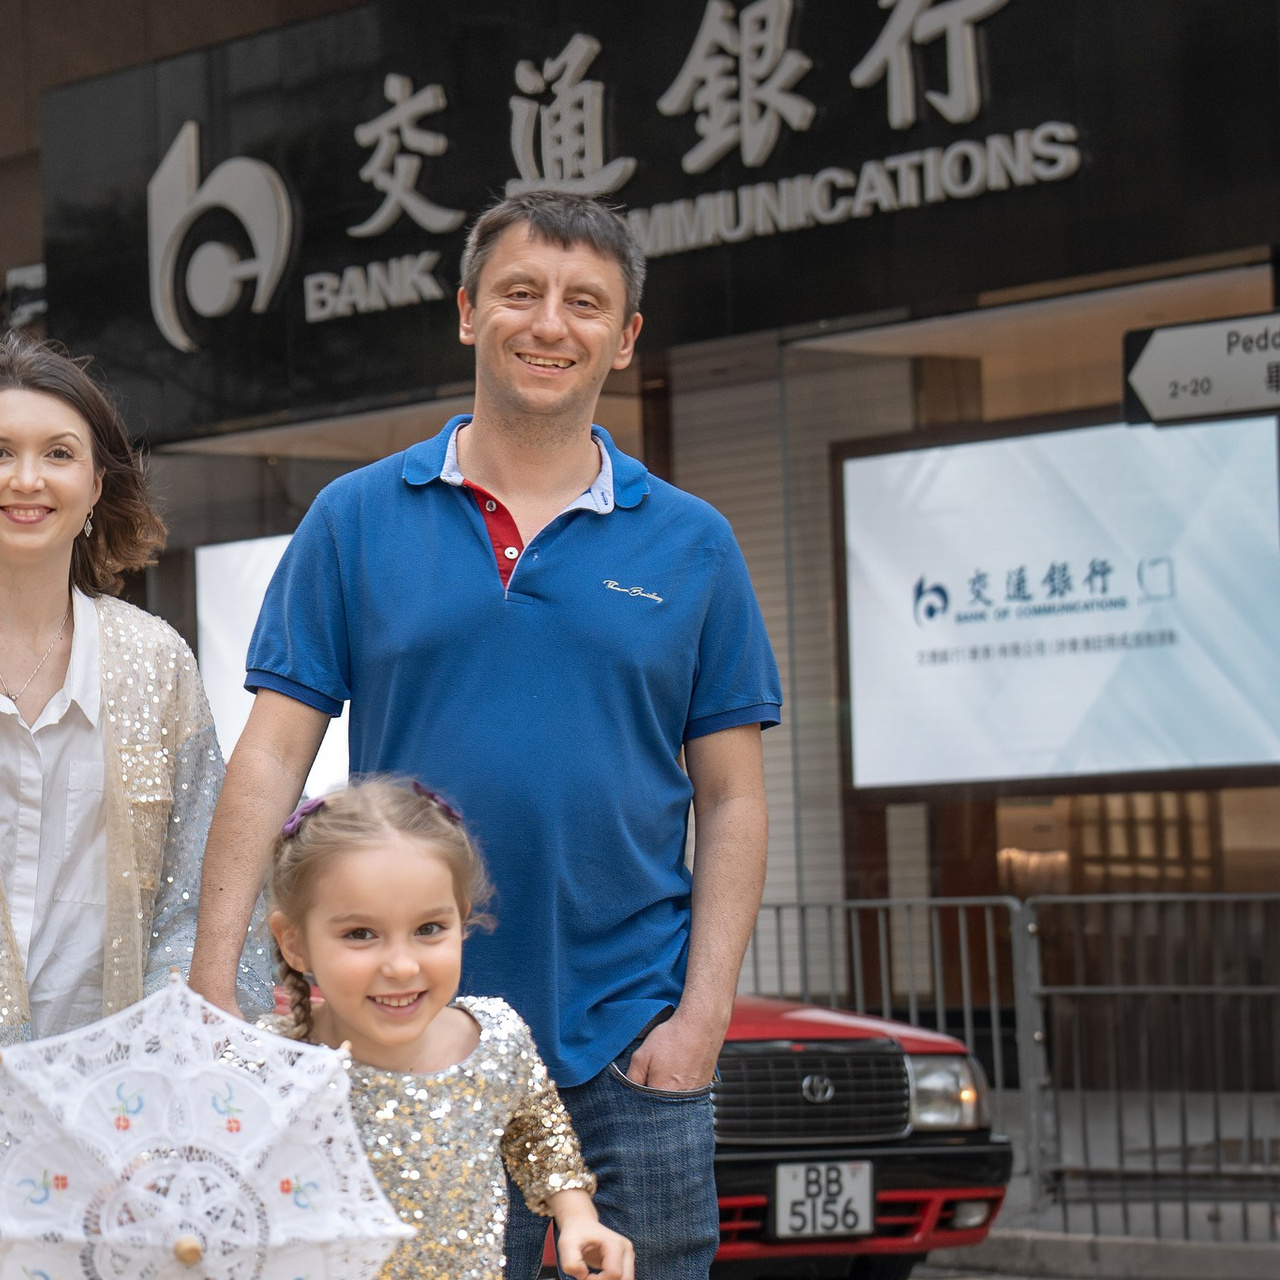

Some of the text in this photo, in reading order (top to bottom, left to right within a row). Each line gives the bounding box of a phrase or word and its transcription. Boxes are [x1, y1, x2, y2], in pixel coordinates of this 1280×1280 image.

[304, 121, 1081, 324] BANK MMUNICATIONS
[967, 557, 1113, 608] 交通銀行
[805, 1166, 842, 1198] BB
[788, 1197, 859, 1233] 5156
